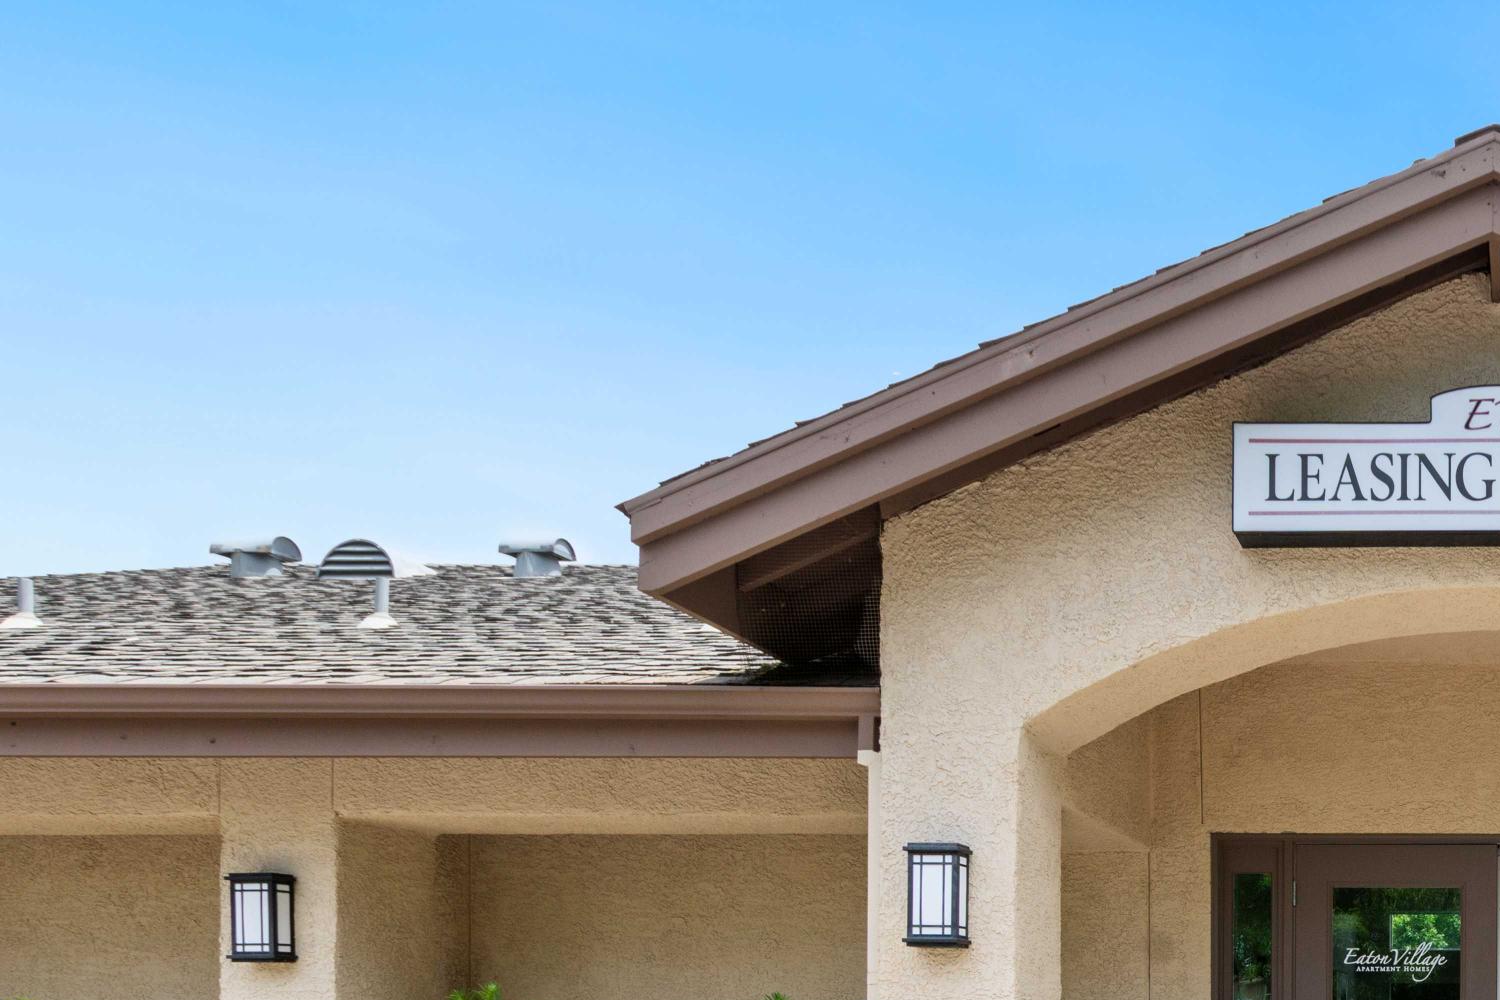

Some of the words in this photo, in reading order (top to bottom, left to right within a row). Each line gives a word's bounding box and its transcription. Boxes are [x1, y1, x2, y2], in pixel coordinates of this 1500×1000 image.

[1264, 451, 1497, 502] LEASING
[1343, 947, 1392, 965] Eaton
[1390, 941, 1448, 982] Village
